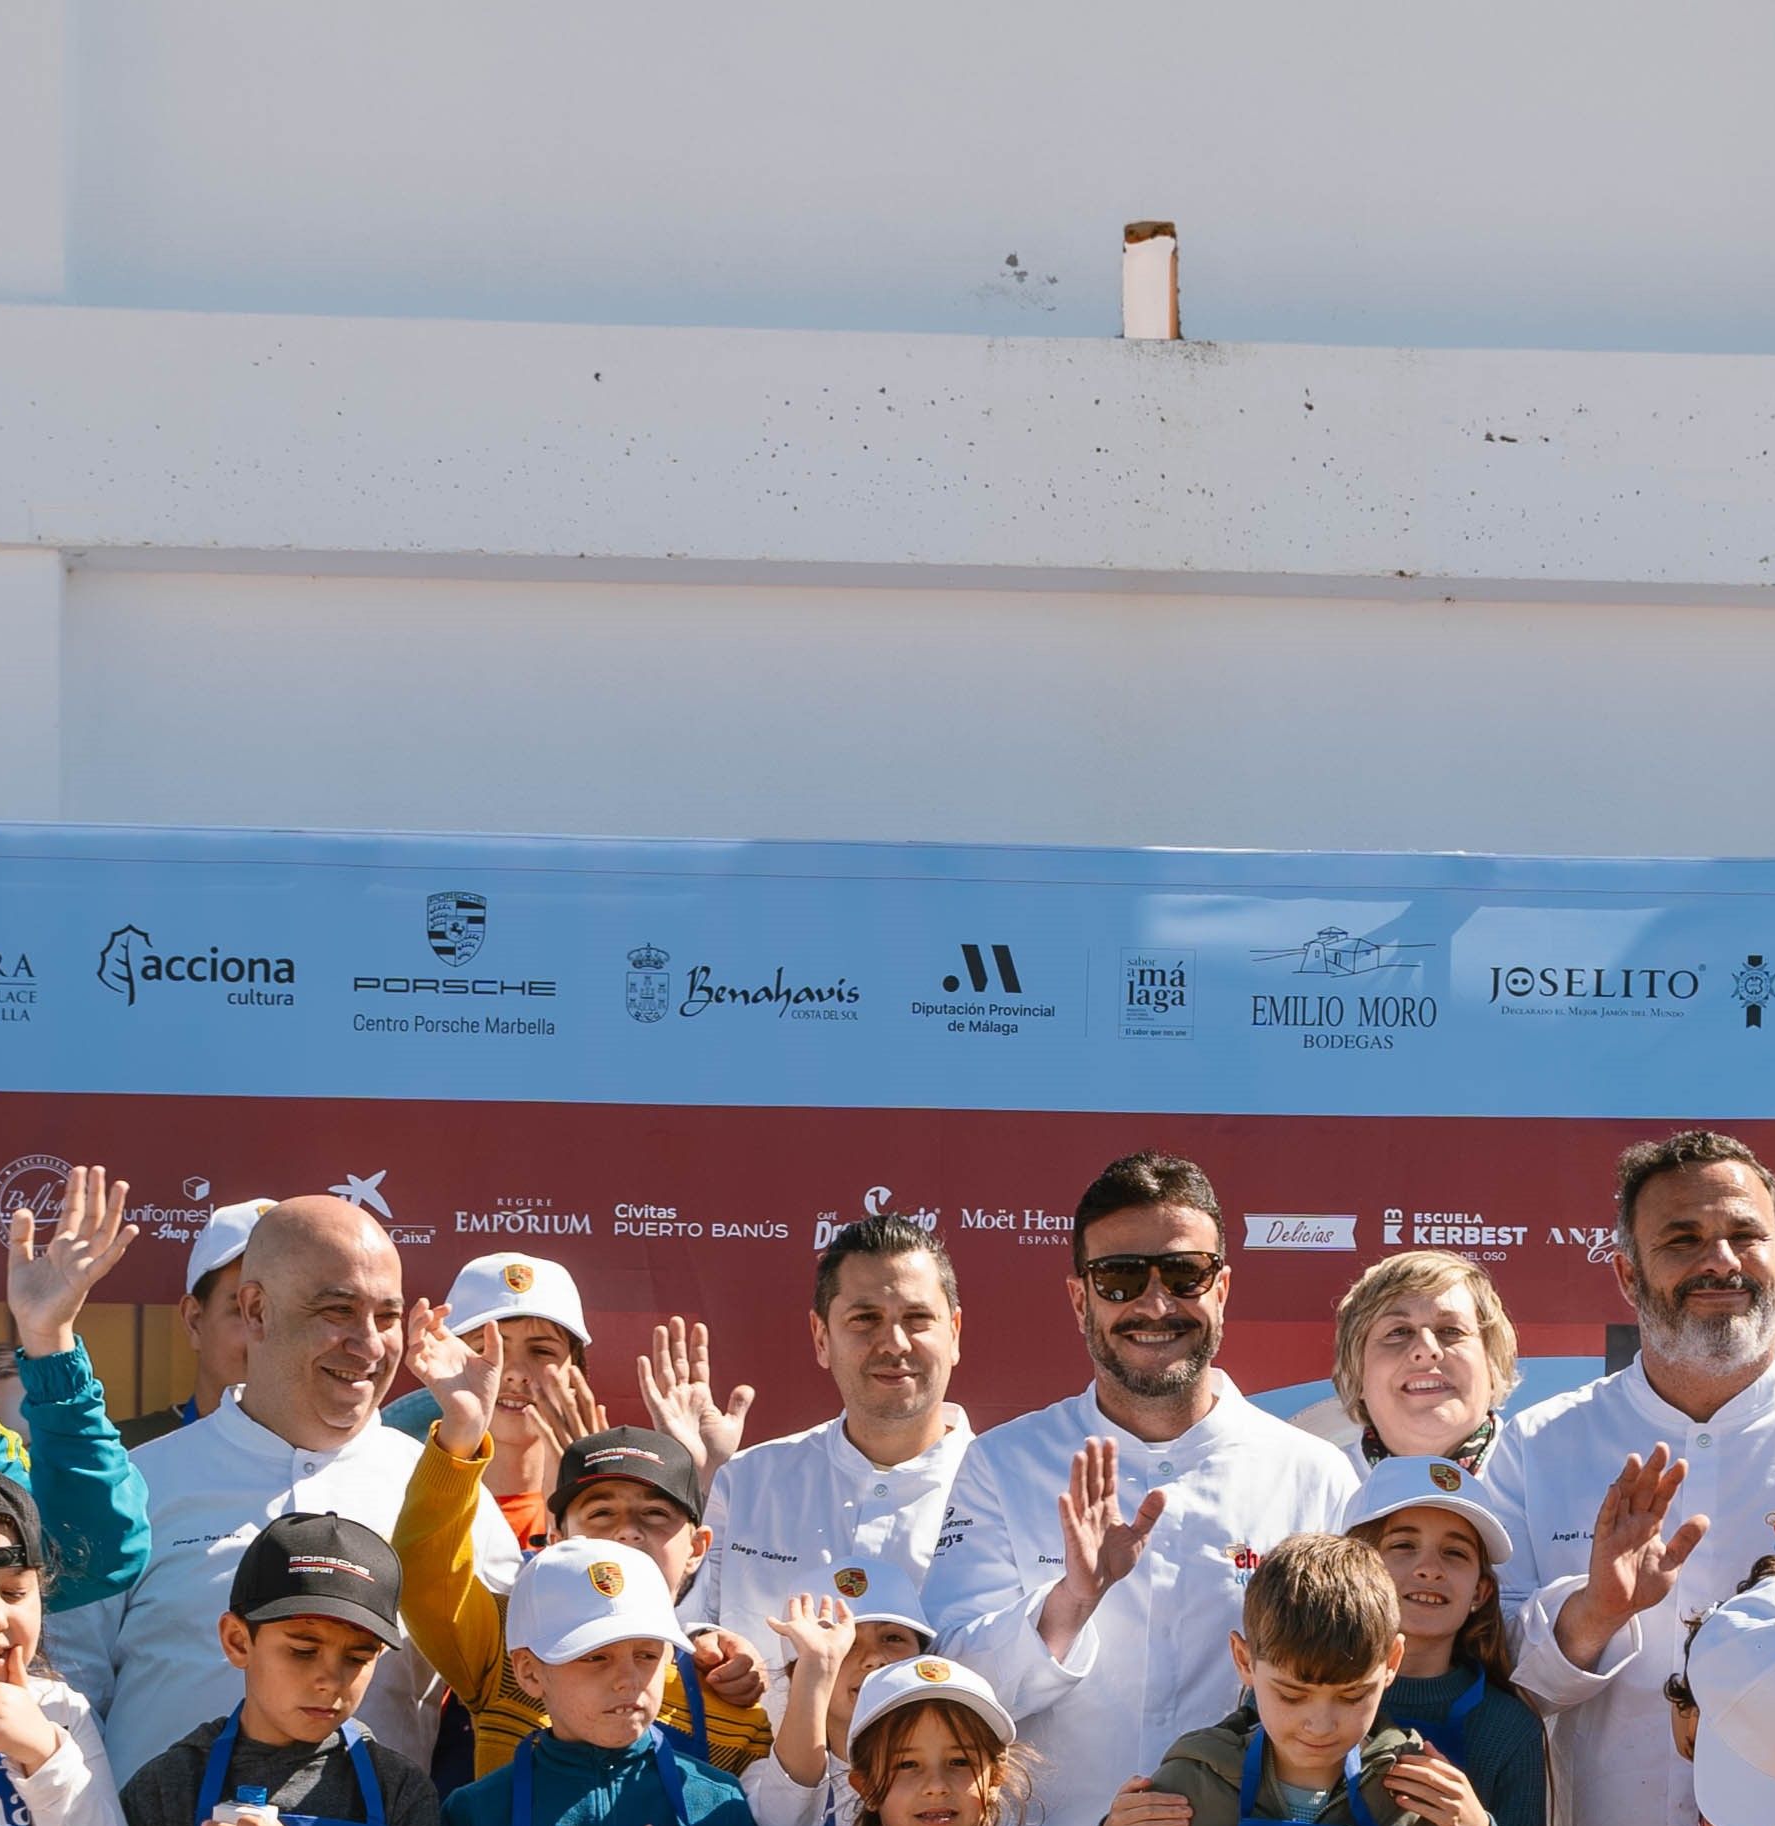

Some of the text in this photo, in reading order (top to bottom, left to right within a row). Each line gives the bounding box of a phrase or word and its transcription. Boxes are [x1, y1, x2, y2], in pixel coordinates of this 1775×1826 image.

[142, 947, 294, 985] acciona
[1137, 961, 1187, 987] má
[354, 977, 556, 996] PORSCHE
[1489, 967, 1699, 1003] JOSELITO
[228, 989, 294, 1007] cultura
[1127, 980, 1186, 1013] laga
[791, 1010, 858, 1020] COSTA DEL SOL
[911, 1001, 1055, 1019] Diputación Provincial
[1252, 995, 1438, 1028] EMILIO MORO
[353, 1015, 555, 1036] Centro Porsche Marbella
[947, 1019, 1019, 1036] de Málaga
[1303, 1034, 1394, 1049] BODEGAS
[497, 1198, 552, 1207] REGERE
[615, 1204, 677, 1221] Cívitas
[817, 1211, 837, 1220] CAFÉ
[960, 1208, 1016, 1229] Moët
[1414, 1213, 1484, 1224] ESCUELA
[614, 1219, 788, 1239] PUERTO BANÚS
[1266, 1220, 1334, 1245] Delicias
[1414, 1227, 1527, 1245] KERBEST
[1019, 1235, 1068, 1245] ESPAÑA
[1483, 1252, 1506, 1261] OSO
[731, 1543, 757, 1555] Diego
[290, 1556, 370, 1575] PORSCHE
